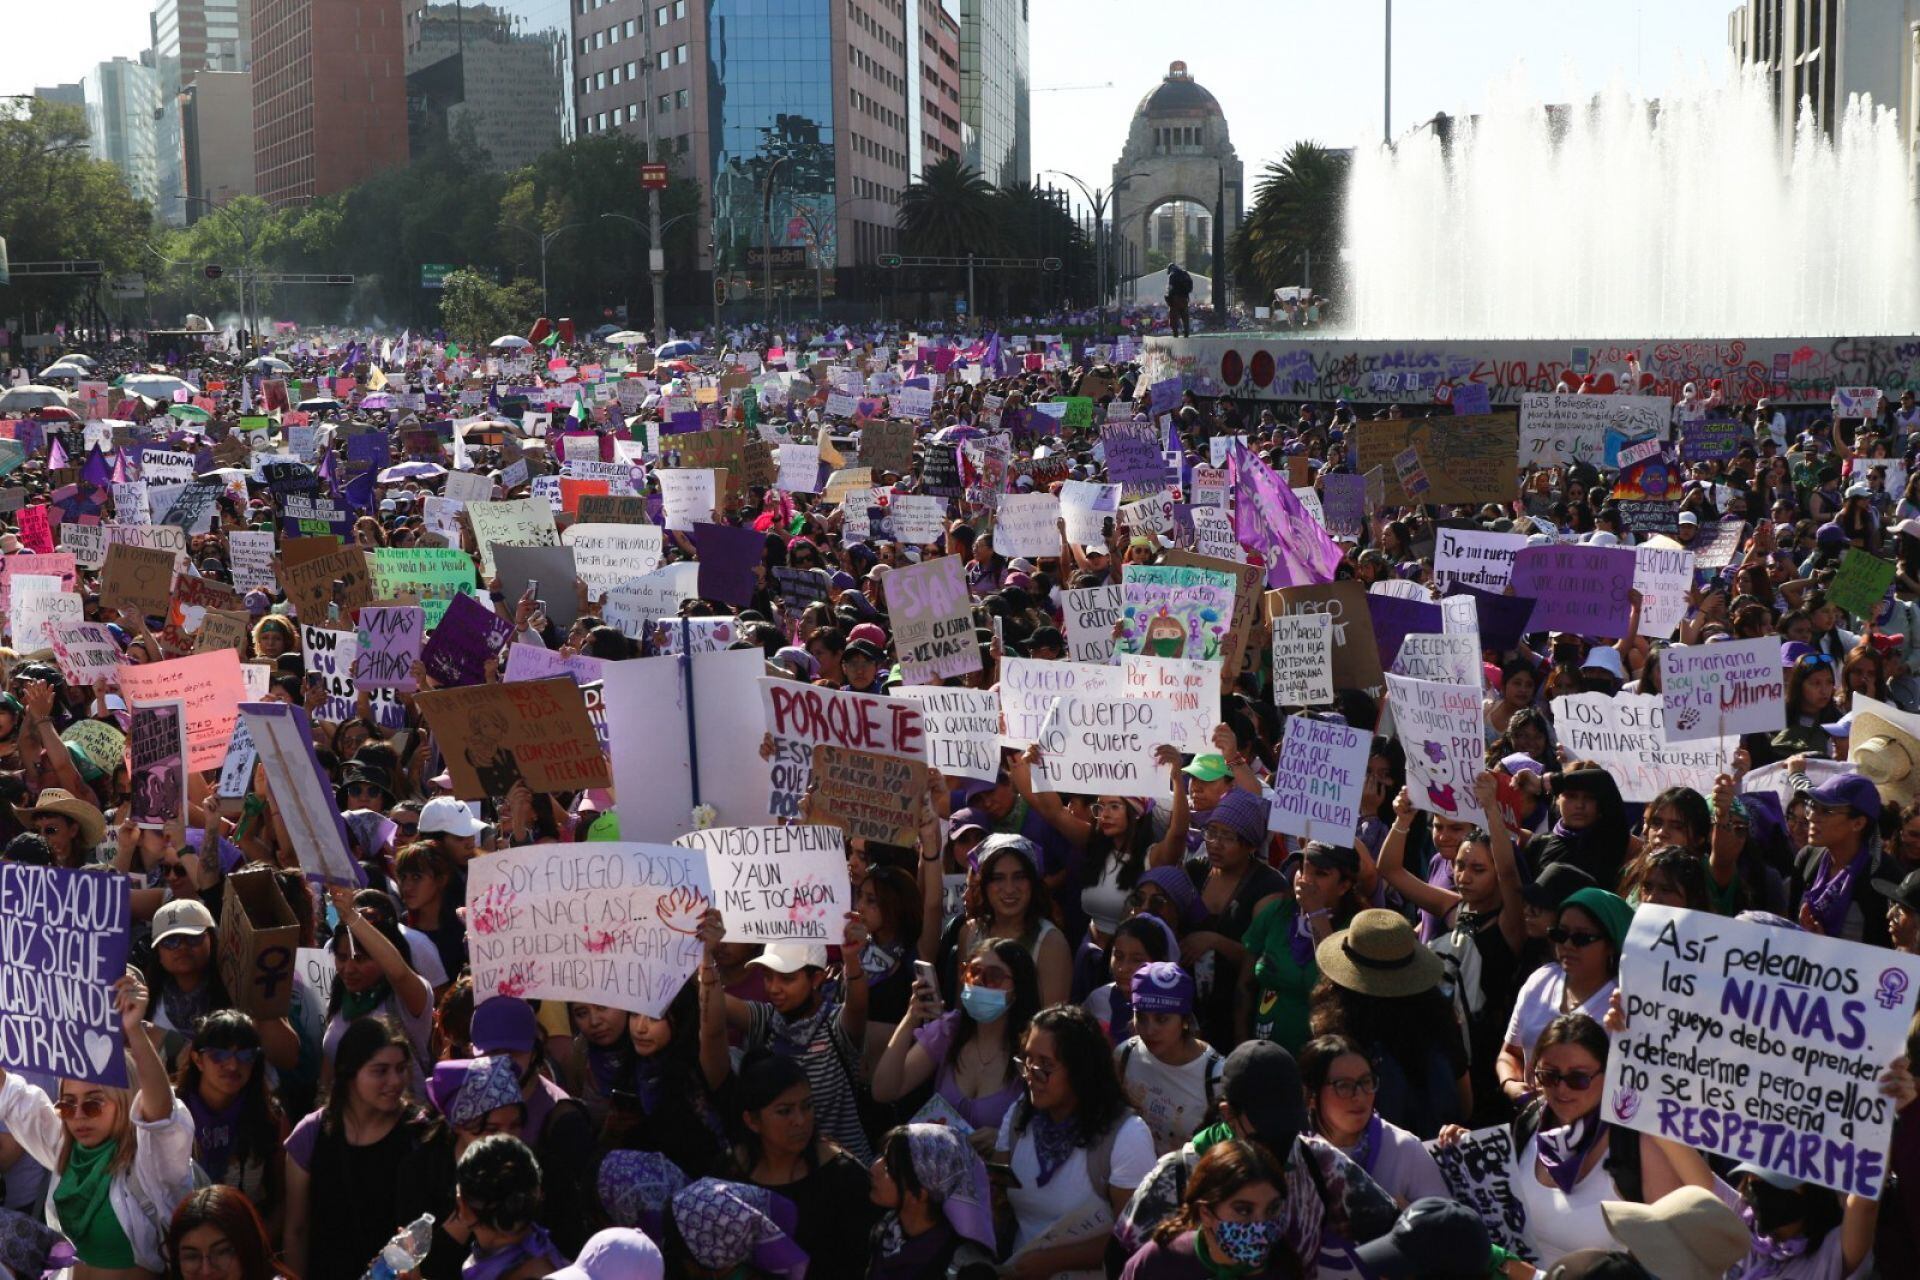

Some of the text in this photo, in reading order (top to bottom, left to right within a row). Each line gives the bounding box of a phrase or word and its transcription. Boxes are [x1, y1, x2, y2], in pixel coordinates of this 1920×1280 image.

[142, 451, 194, 467] CHILLONA
[1133, 499, 1161, 520] UNA
[1197, 520, 1229, 530] SOMOS
[1204, 542, 1236, 559] SOMOS
[1441, 534, 1463, 558] De
[1467, 546, 1479, 558] mi
[886, 558, 967, 619] ESTAR
[1462, 565, 1508, 586] vestuari
[1069, 588, 1100, 613] QUE
[364, 608, 415, 634] VIVAS
[305, 626, 337, 652] CON
[382, 634, 396, 652] Y
[1077, 641, 1104, 662] LOS
[355, 650, 413, 681] CHIDAS
[1405, 657, 1449, 676] VIVIR
[1667, 651, 1756, 675] Si mañana
[1127, 662, 1203, 694] Por las que
[1666, 667, 1771, 694] soy yo quiero
[982, 695, 995, 712] YA
[1417, 682, 1437, 707] los
[1663, 692, 1688, 709] ser
[1696, 686, 1712, 705] la
[944, 715, 999, 736] QUEREMOS
[1412, 706, 1452, 734] siguen
[1564, 698, 1604, 727] LOS
[887, 703, 923, 753] TE
[1571, 727, 1661, 752] FAMILIARES
[931, 738, 992, 772] LIBRES
[1037, 730, 1142, 755] NO quiere
[1284, 737, 1332, 763] POR QUE
[1451, 736, 1482, 760] PRO
[1072, 758, 1138, 784] opinión
[1279, 755, 1354, 787] CUANDO ME
[1638, 750, 1727, 768] ENCUBREN
[1309, 777, 1319, 795] A
[1321, 779, 1341, 802] MI
[1311, 802, 1351, 826] CULPA
[708, 827, 759, 856] VISTO
[495, 851, 698, 897] SOY FUEGO DESDE
[731, 861, 782, 888] Y AUN
[2, 864, 126, 934] ESTAS AQUI
[724, 889, 756, 913] ME
[41, 923, 112, 985] SIGUE
[476, 937, 505, 964] NO
[512, 930, 592, 955] PUEDEN
[1649, 918, 1860, 995] Así peleamos
[550, 958, 620, 995] HABITA
[628, 961, 651, 1002] EN
[1661, 960, 1698, 997] las
[88, 984, 120, 1033] DE
[1626, 993, 1667, 1029] por
[1729, 1023, 1787, 1058] debo
[1791, 1043, 1884, 1082] aprender
[1633, 1031, 1750, 1088] defenderme
[1758, 1070, 1803, 1101] pero
[1824, 1083, 1888, 1125] ellos
[1619, 1063, 1855, 1141] no se les enseña a
[1656, 1098, 1884, 1198] RESPETARME
